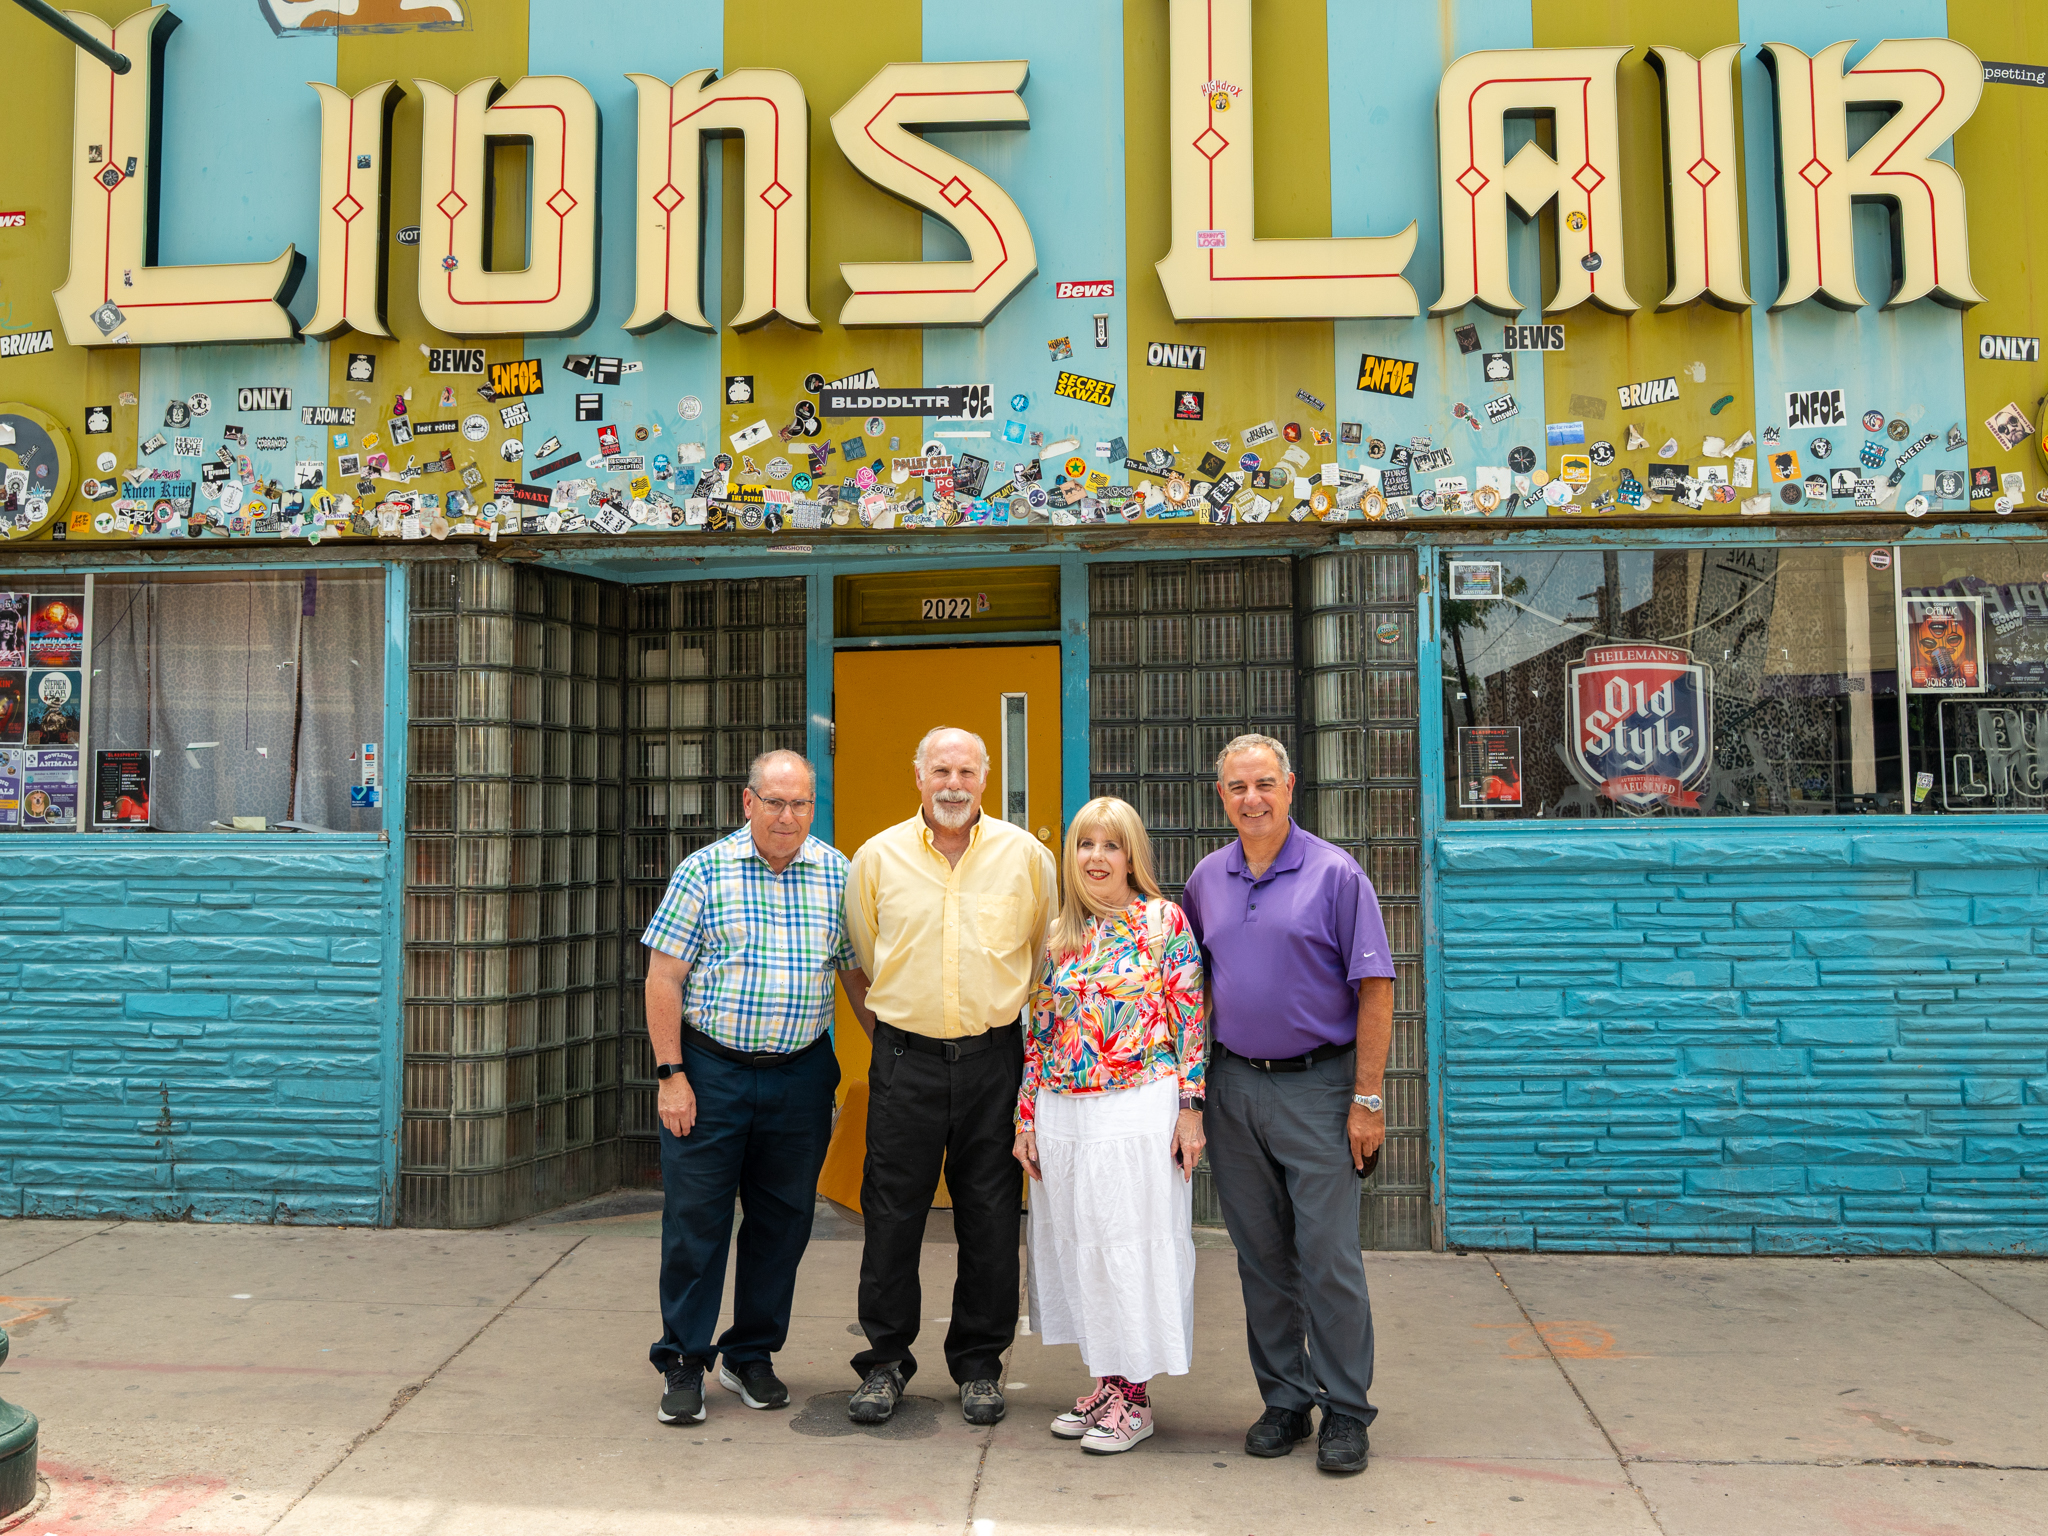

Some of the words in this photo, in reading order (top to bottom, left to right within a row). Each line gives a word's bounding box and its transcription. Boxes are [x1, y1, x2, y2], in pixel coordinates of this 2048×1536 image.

[1984, 68, 2046, 85] psetting
[399, 230, 421, 242] KOT
[1198, 238, 1226, 248] LOGIN
[1057, 282, 1114, 298] Bews
[0, 331, 53, 357] BRUHA
[1504, 325, 1564, 350] BEWS
[429, 349, 485, 373] BEWS
[492, 360, 542, 397] INFOE
[1058, 372, 1115, 395] SECRET
[1359, 356, 1414, 395] INFOE
[1055, 383, 1111, 407] SKWAD
[1617, 378, 1679, 408] BRUHA
[501, 402, 527, 418] FAST
[1486, 394, 1513, 417] FAST
[1788, 390, 1845, 429] INFOE
[302, 408, 313, 425] THE
[315, 408, 339, 424] ATOM
[340, 408, 355, 425] AGE
[504, 412, 530, 429] JUDY
[1246, 428, 1274, 444] GENTRY
[1895, 434, 1933, 468] AMERIC
[930, 456, 953, 468] CITY
[1127, 460, 1138, 469] The
[928, 467, 948, 475] SHOW
[160, 481, 191, 498] Krüe
[937, 478, 954, 489] PG
[764, 489, 791, 503] UNION
[923, 599, 971, 620] 2022
[1925, 606, 1944, 616] OPEN
[1944, 606, 1958, 616] MIC
[1992, 609, 2020, 627] GONG
[1995, 617, 2023, 635] SHOW
[1593, 650, 1680, 663] HEILEMAN'S
[0, 680, 13, 688] KIN'
[44, 680, 67, 690] STEPHEN
[1604, 675, 1674, 719] Old
[1585, 709, 1691, 771] Style
[38, 760, 78, 768] ANIMALS
[44, 752, 73, 761] BOWLING
